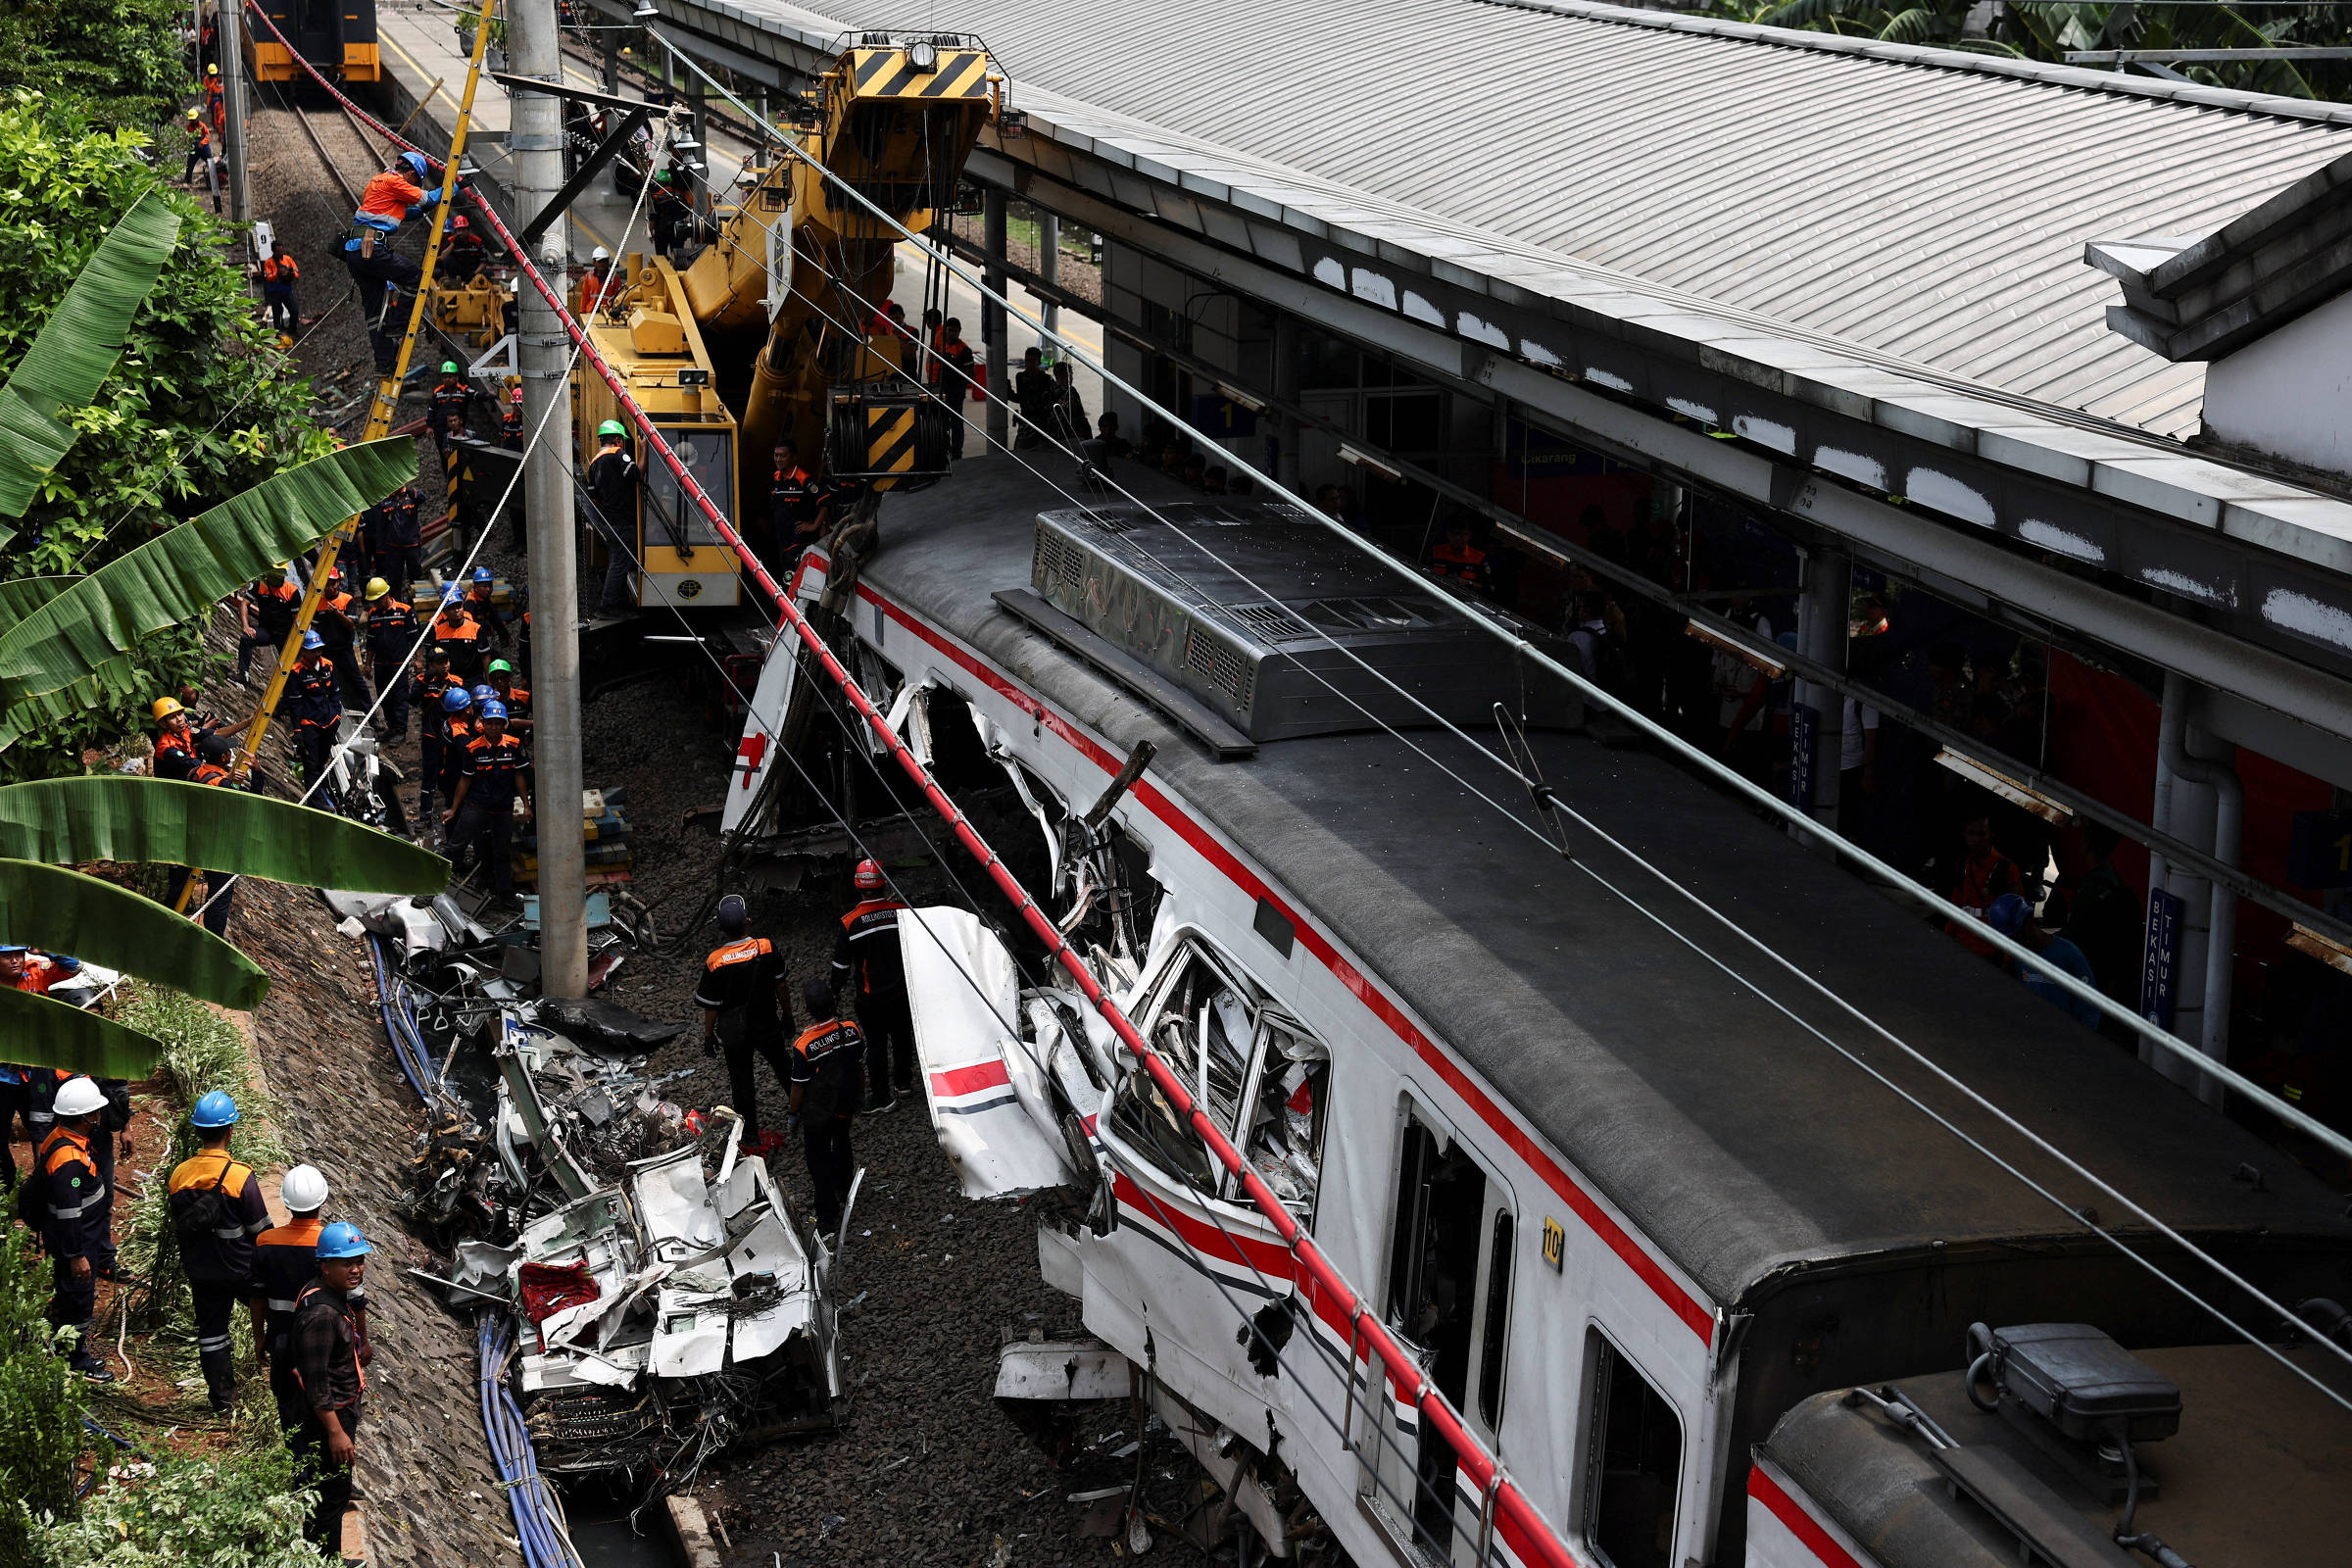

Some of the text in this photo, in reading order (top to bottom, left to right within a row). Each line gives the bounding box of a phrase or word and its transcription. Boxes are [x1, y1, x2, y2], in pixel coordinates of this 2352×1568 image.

[261, 235, 268, 245] 9
[1219, 402, 1233, 429] 1
[1521, 454, 1577, 465] Cikarang
[1791, 712, 1801, 795] BEKASI
[1800, 722, 1810, 793] TIMUR
[2147, 901, 2161, 999] BEKASI
[2159, 914, 2173, 997] TIMUR
